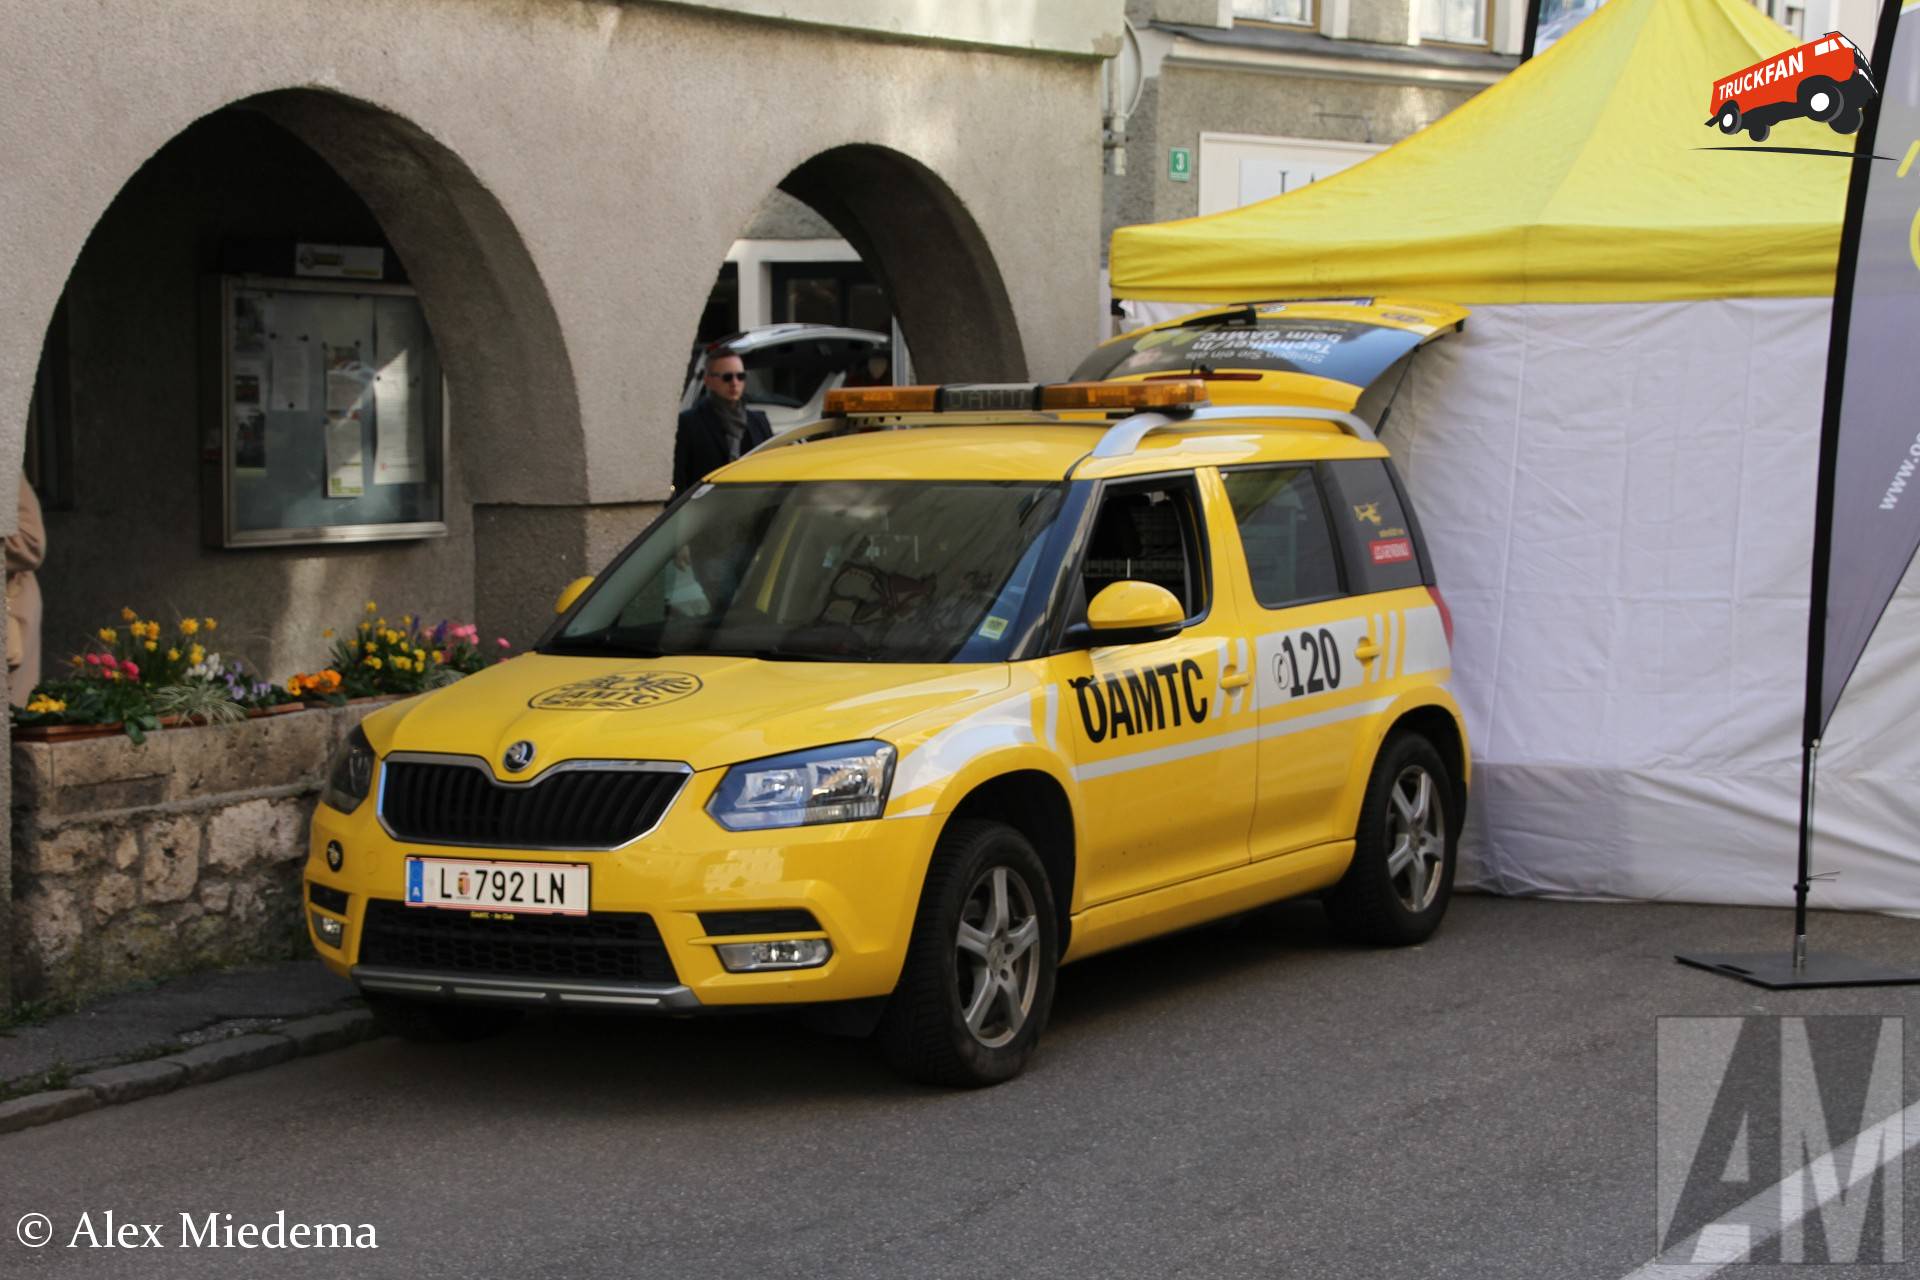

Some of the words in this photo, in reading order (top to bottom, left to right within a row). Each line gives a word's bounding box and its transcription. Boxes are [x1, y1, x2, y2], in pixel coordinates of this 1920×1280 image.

[1175, 152, 1185, 171] 3
[1285, 331, 1343, 345] beim
[1281, 627, 1341, 698] 120
[440, 867, 452, 899] L
[474, 869, 524, 902] 792
[533, 872, 565, 905] LN
